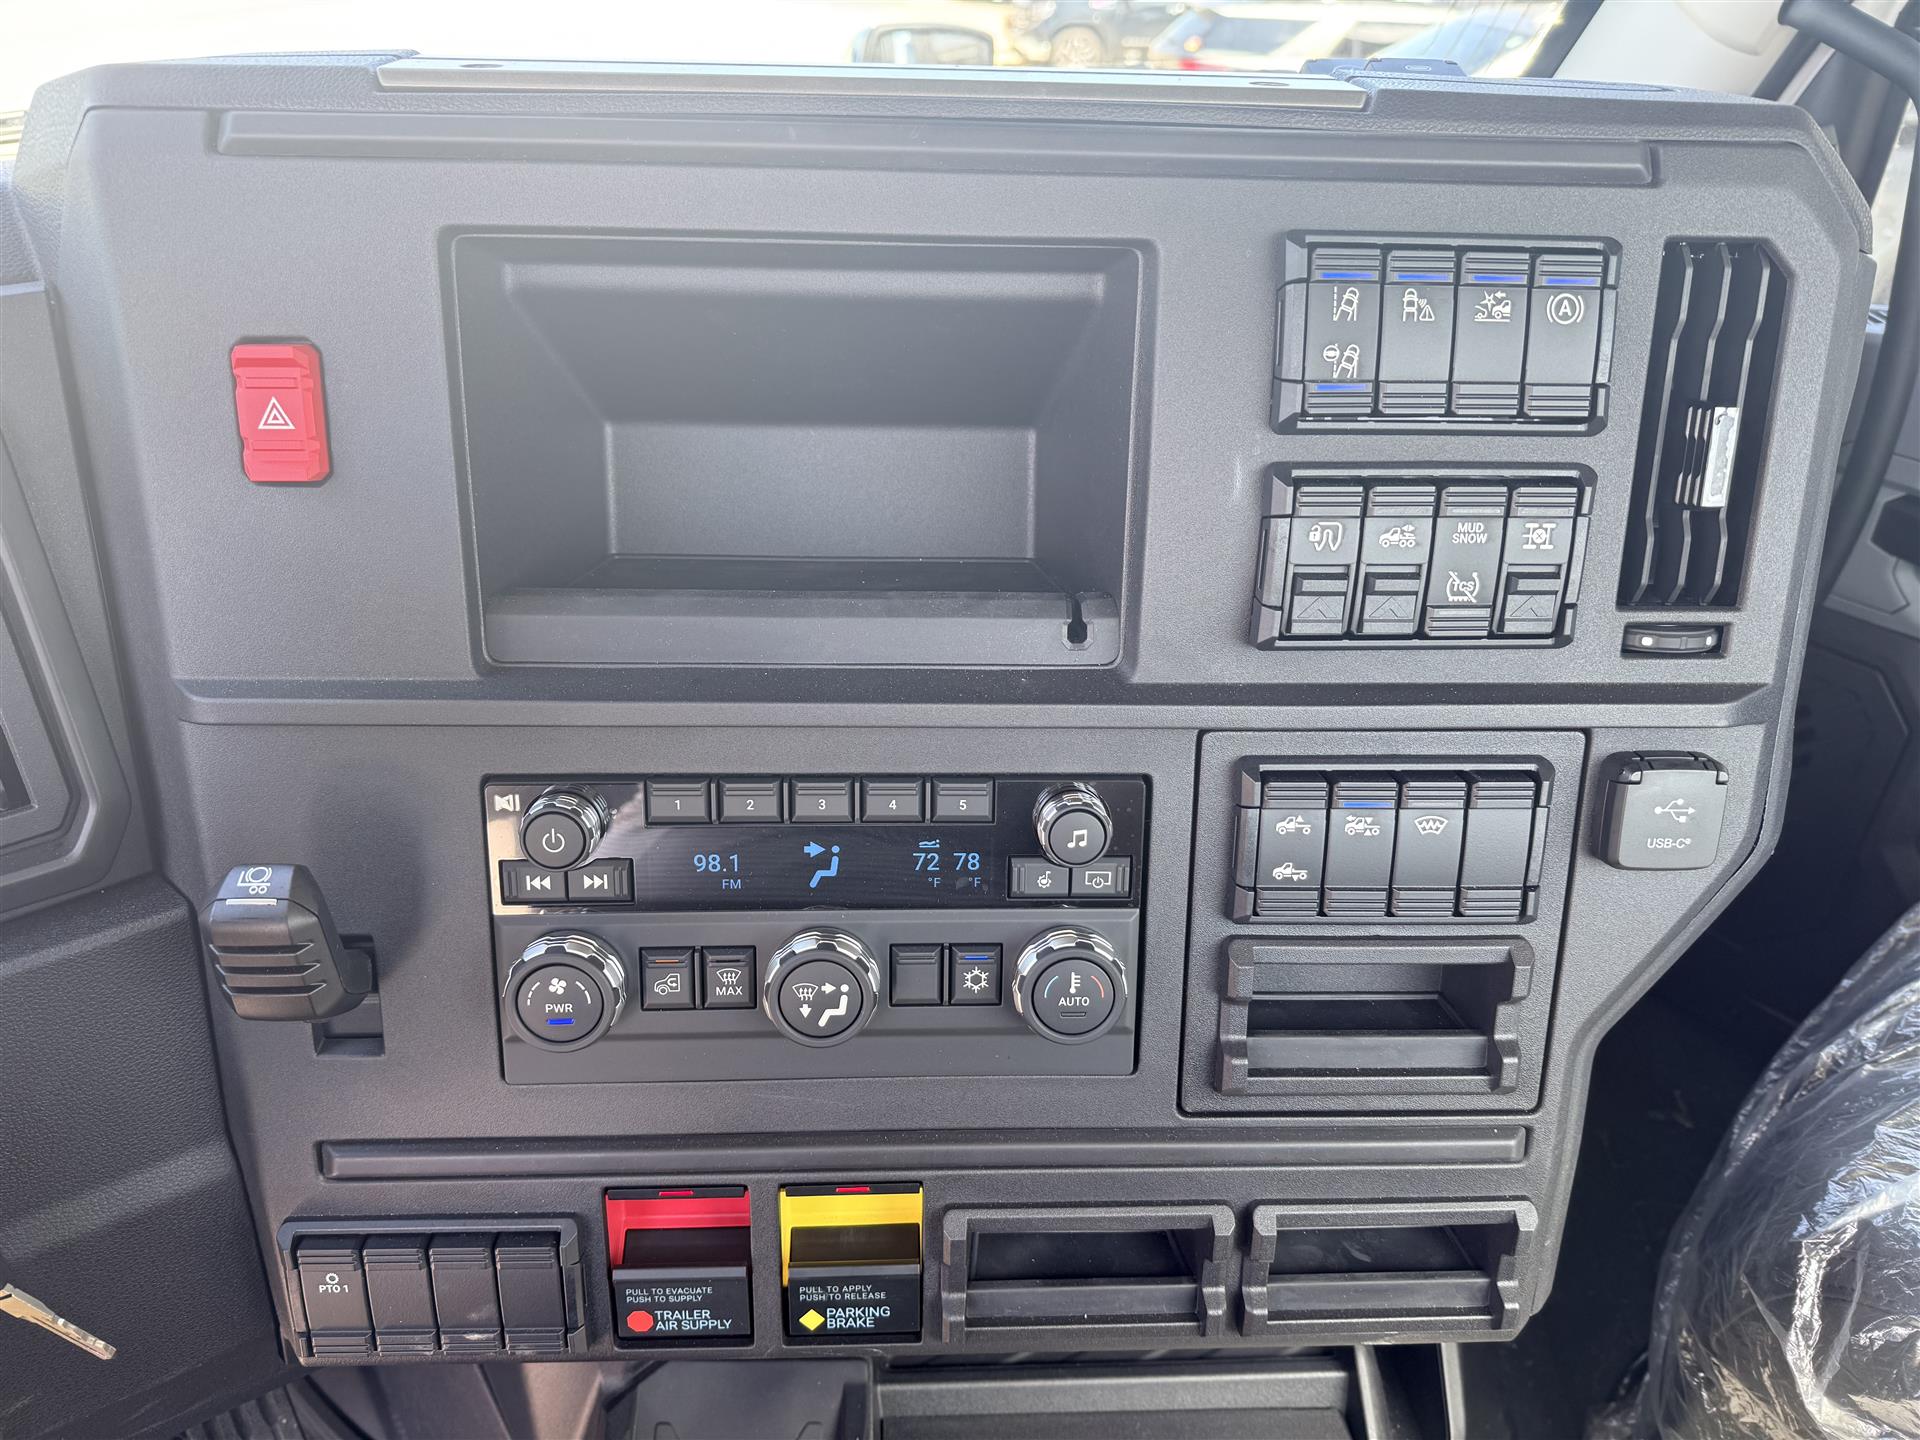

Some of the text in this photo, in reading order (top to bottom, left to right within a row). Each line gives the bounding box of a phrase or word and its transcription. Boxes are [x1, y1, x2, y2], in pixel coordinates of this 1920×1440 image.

[1457, 522, 1484, 533] MUD
[1452, 532, 1488, 544] SNOW
[674, 800, 680, 810] 1
[746, 800, 754, 810] 2
[818, 800, 826, 810] 3
[889, 800, 896, 810] 4
[959, 800, 967, 810] 5
[693, 854, 739, 873] 98.1
[912, 853, 980, 871] 72 78
[722, 879, 742, 890] FM
[928, 877, 981, 887] °F °F
[716, 986, 743, 996] MAX
[1058, 997, 1089, 1007] AUTO
[545, 1003, 573, 1013] PWR
[318, 1284, 349, 1293] PTO 1
[666, 1286, 713, 1295] EVACUATE
[844, 1292, 886, 1300] RELEASE
[655, 1310, 711, 1320] TRAILER
[826, 1306, 890, 1319] PARKING
[655, 1319, 732, 1331] AIR SUPPLY
[826, 1317, 875, 1329] BRAKE
